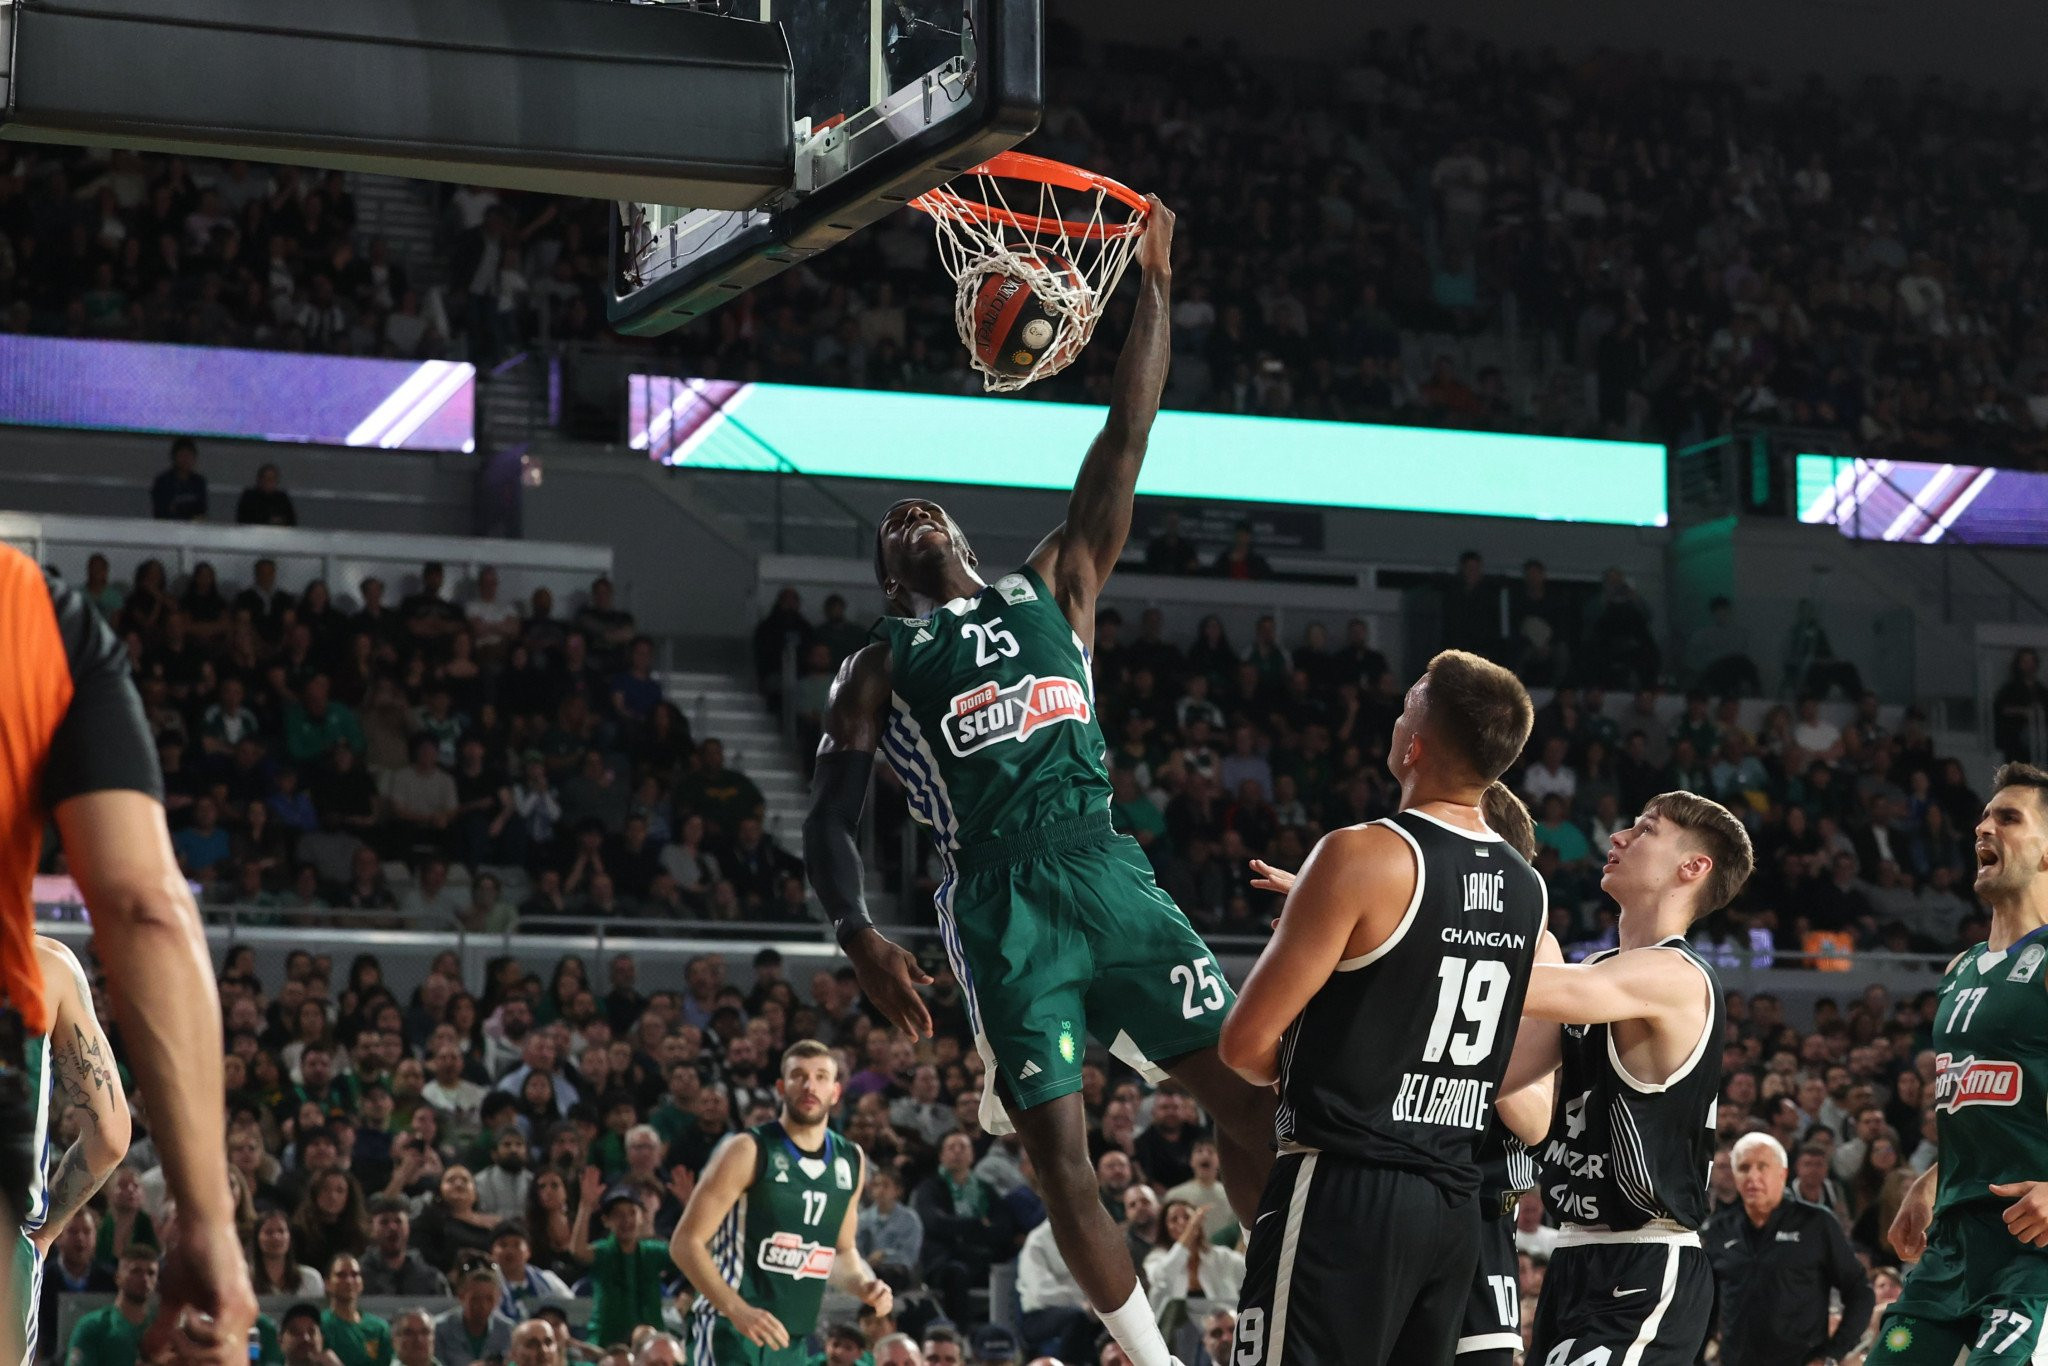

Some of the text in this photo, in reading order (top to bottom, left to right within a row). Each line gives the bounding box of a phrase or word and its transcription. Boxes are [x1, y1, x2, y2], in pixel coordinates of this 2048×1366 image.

[961, 617, 1020, 667] 25
[1463, 870, 1504, 913] LAKIĆ
[1441, 927, 1526, 950] CHANGAN
[1170, 956, 1225, 1019] 25
[1422, 955, 1511, 1065] 19
[1945, 987, 1989, 1034] 77
[1391, 1073, 1493, 1131] BELGRADE
[802, 1189, 828, 1226] 17
[1487, 1275, 1519, 1329] 10
[1976, 1309, 2033, 1355] 77
